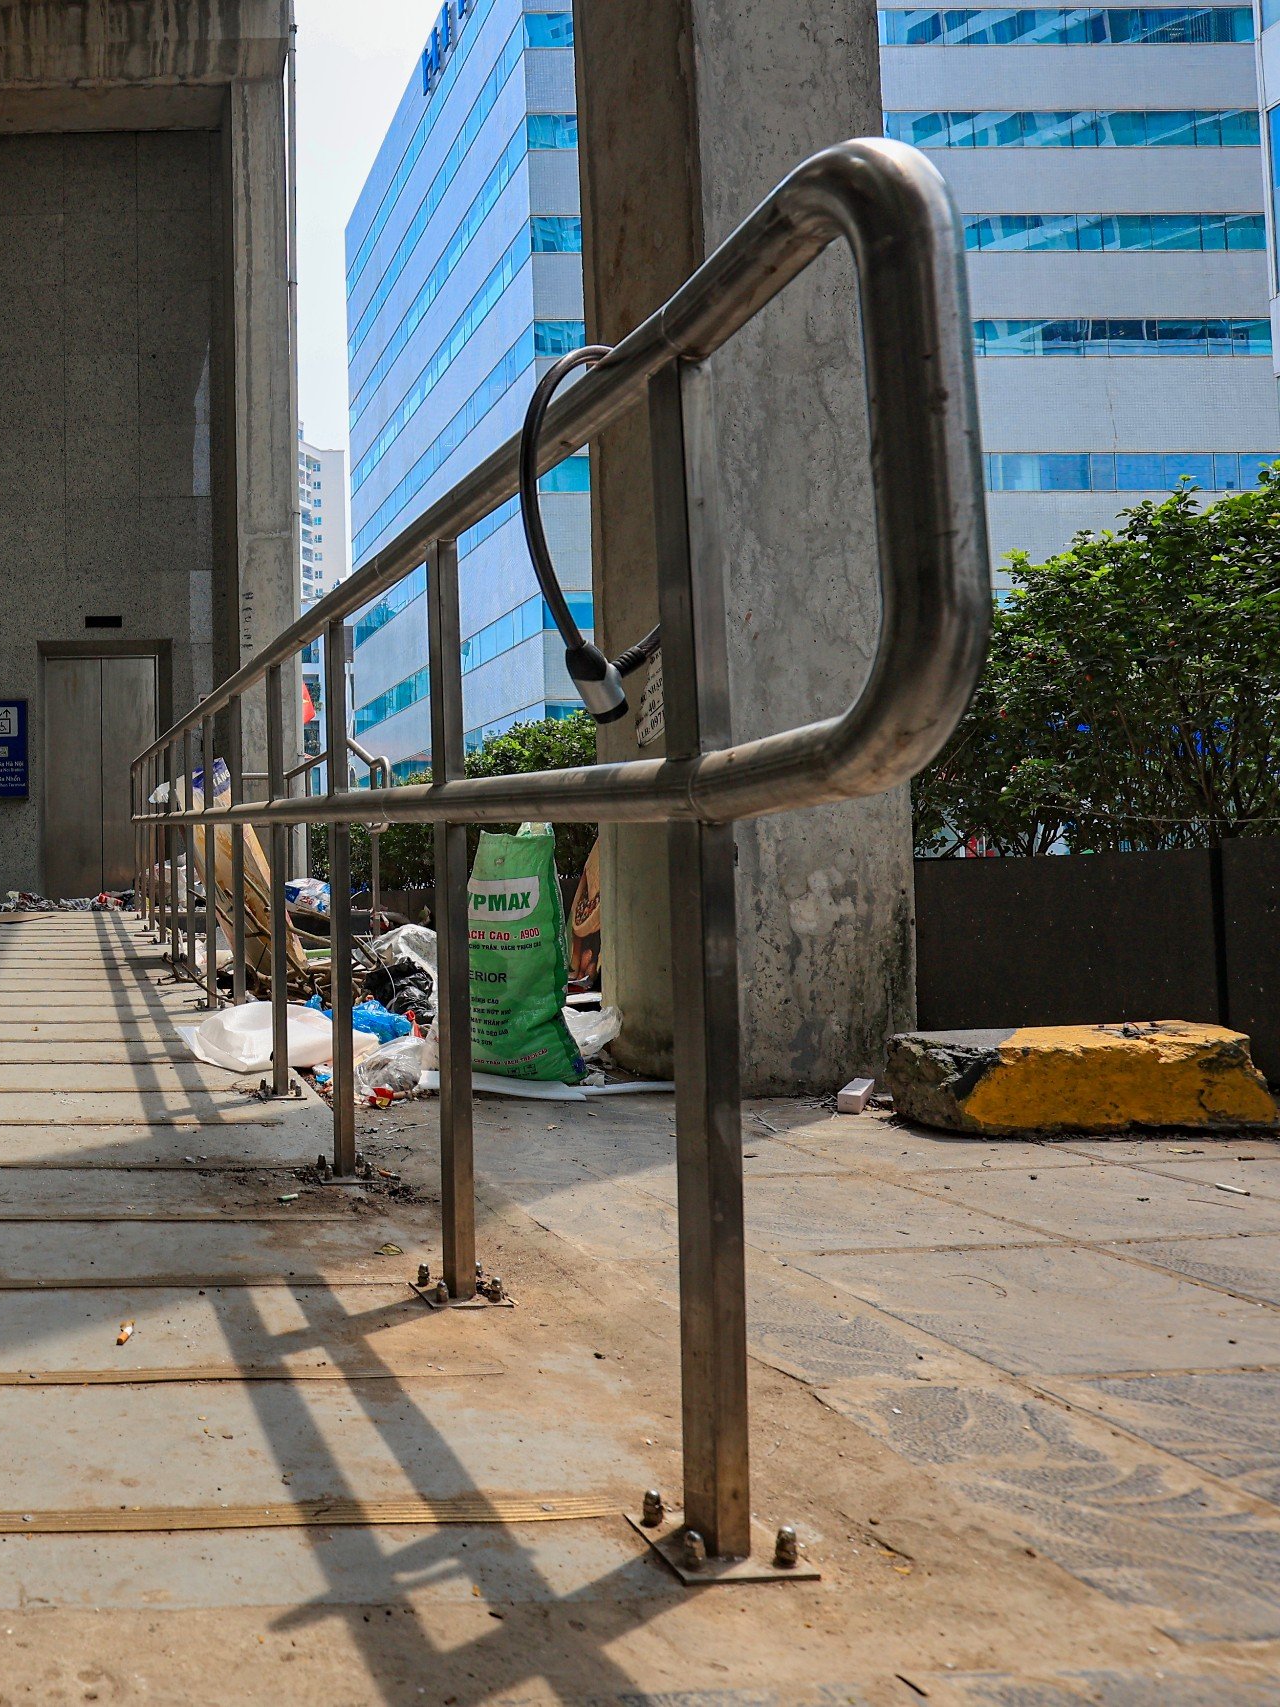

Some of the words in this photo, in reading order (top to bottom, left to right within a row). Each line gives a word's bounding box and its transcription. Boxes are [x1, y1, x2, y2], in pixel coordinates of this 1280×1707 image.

[467, 892, 531, 911] PMAX
[489, 931, 510, 941] CAO
[520, 928, 540, 939] A900
